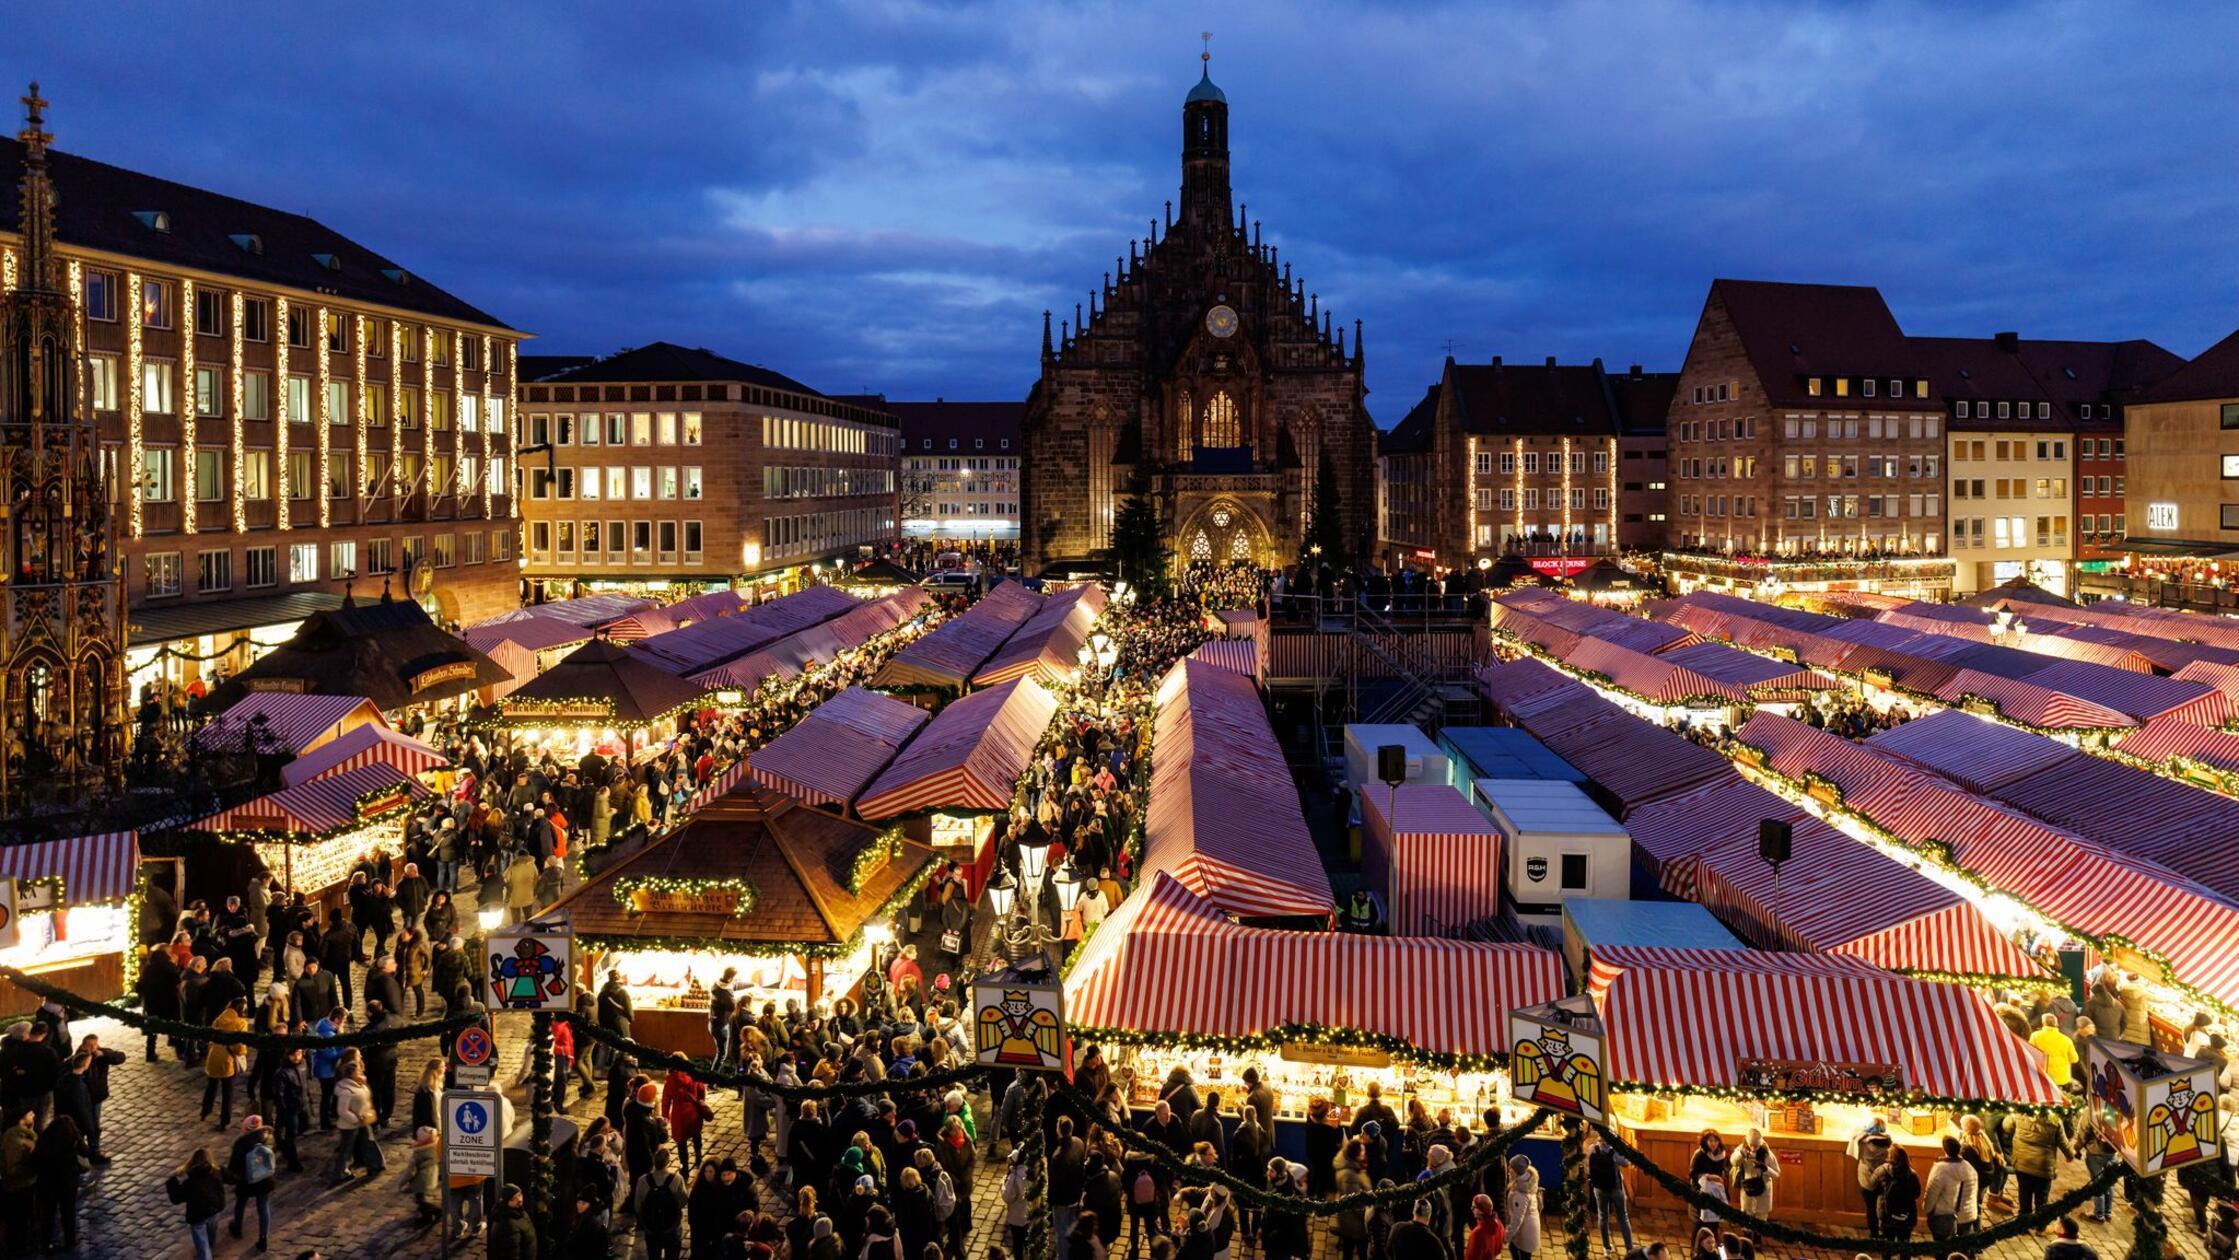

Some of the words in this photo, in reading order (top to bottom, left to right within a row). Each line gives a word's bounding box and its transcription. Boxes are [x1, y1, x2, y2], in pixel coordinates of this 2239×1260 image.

[2148, 506, 2175, 528] ALEX
[1532, 560, 1559, 568] BLOCK
[459, 1135, 484, 1145] ZONE
